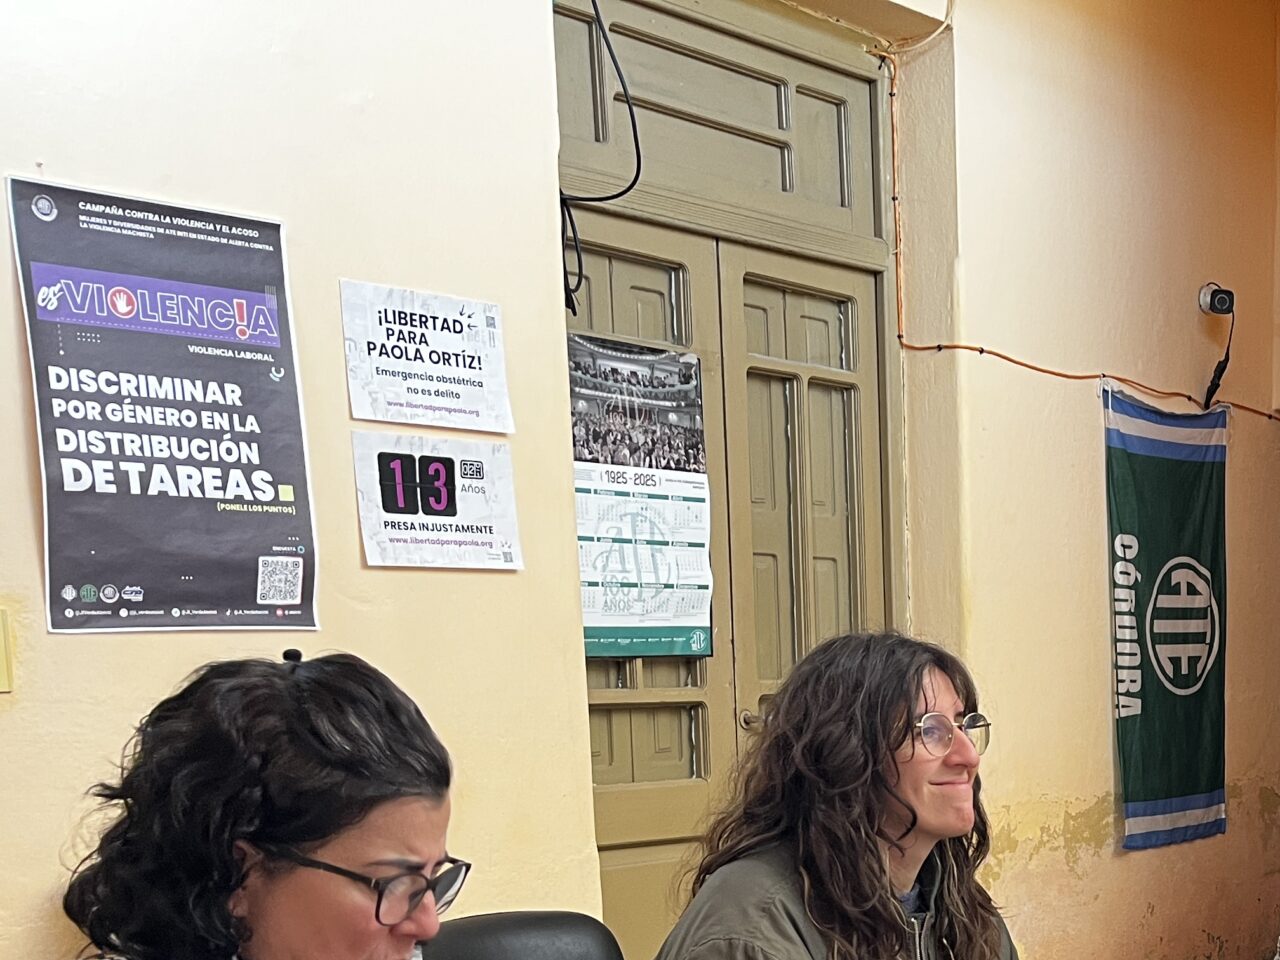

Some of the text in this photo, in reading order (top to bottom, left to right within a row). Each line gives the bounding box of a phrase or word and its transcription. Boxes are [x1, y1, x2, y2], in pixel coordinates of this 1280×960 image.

[79, 202, 124, 216] CAMPAÑA
[125, 209, 160, 221] CONTRA
[160, 215, 171, 224] LA
[172, 217, 214, 230] VIOLENCIA
[231, 226, 259, 238] ACOSO
[377, 308, 464, 334] ¡LIBERTAD
[386, 327, 429, 347] PARA
[187, 344, 274, 362] VIOLENCIA LABORAL
[366, 340, 483, 371] PAOLA ORTÍZ!
[47, 365, 243, 406] DISCRIMINAR
[375, 366, 484, 388] Emergencia obstétrica
[407, 386, 461, 399] no es delito
[51, 397, 262, 434] POR GÉNERO EN LA
[55, 428, 260, 465] DISTRIBUCIÓN
[59, 457, 117, 494] DE
[390, 458, 449, 511] 13
[460, 483, 486, 494] Años
[249, 504, 262, 512] LOS
[383, 520, 494, 535] PRESA INJUSTAMENTE
[1153, 568, 1211, 679] ATE
